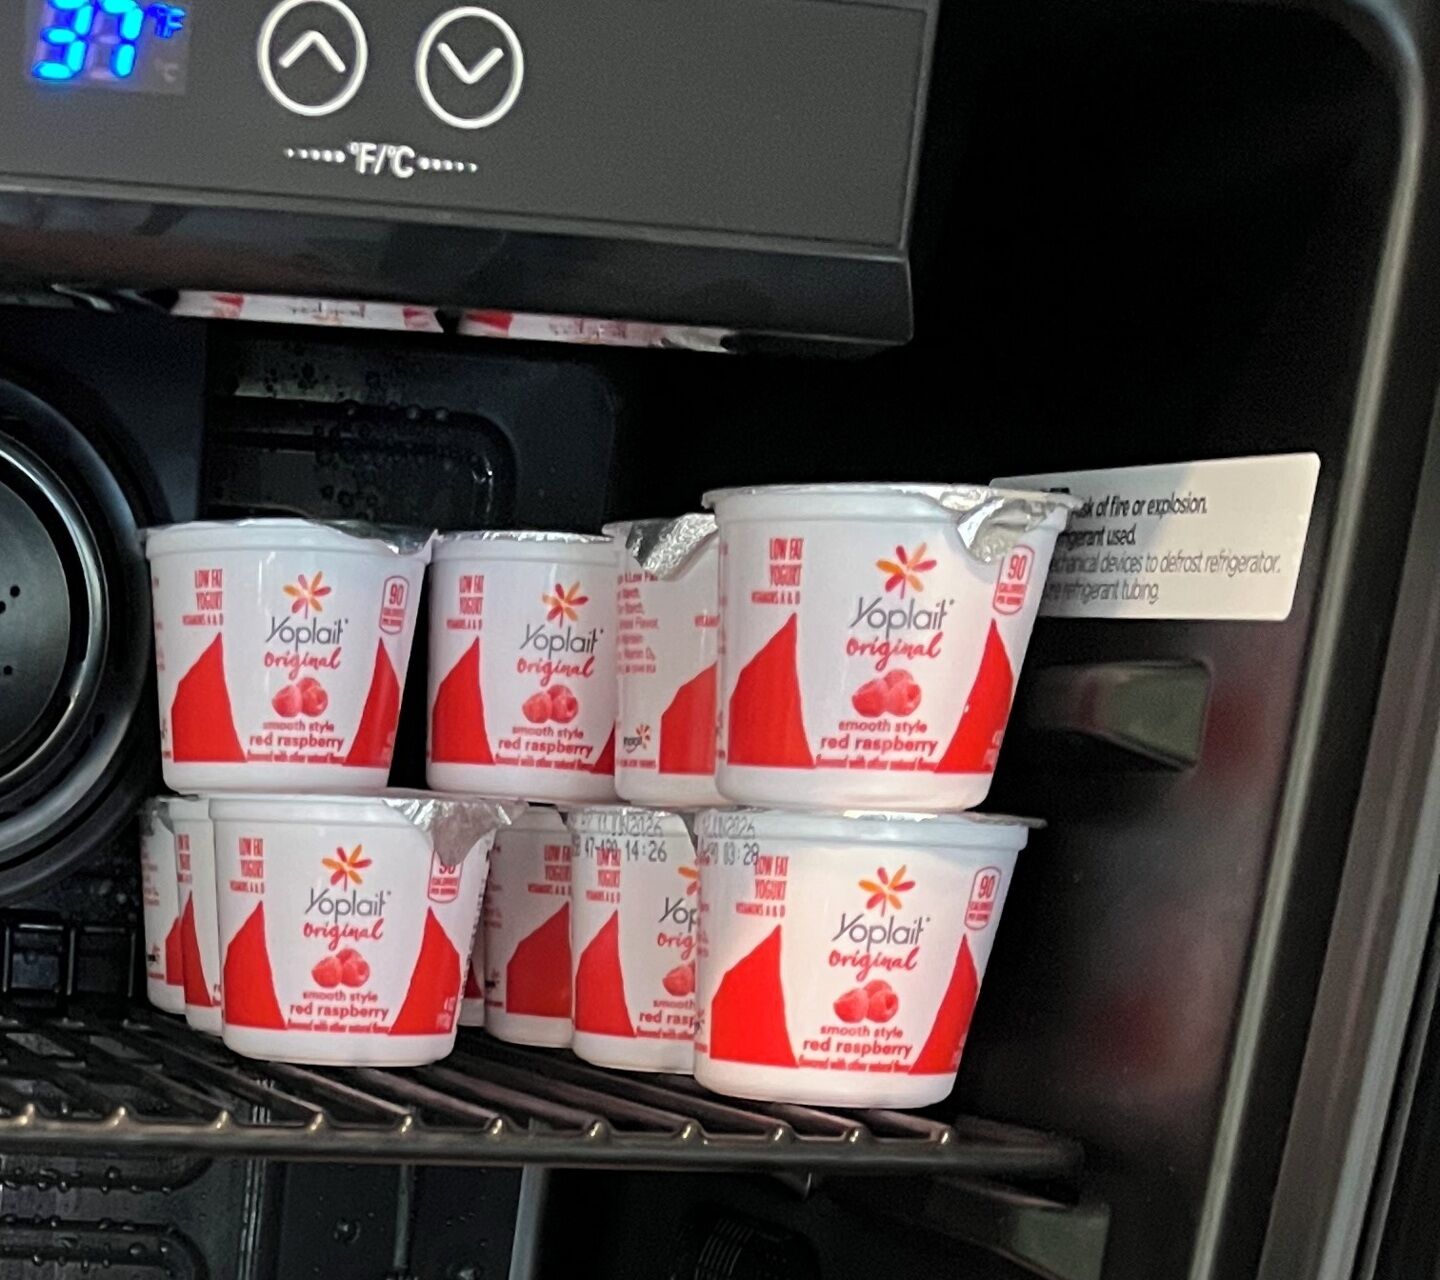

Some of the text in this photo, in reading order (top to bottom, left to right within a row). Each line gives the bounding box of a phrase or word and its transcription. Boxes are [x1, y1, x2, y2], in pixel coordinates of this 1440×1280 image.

[32, 0, 143, 79] 37
[1132, 498, 1146, 515] or
[769, 537, 804, 561] LOW FAT
[1007, 554, 1029, 581] 90
[1145, 553, 1158, 574] to
[1159, 549, 1204, 574] defrost
[1204, 549, 1281, 577] refrigerator.
[194, 568, 223, 589] LOW FAT
[769, 563, 802, 588] YOGURT
[389, 583, 404, 606] 90
[849, 596, 948, 641] Yoplait
[265, 616, 344, 651] Yoplait
[520, 623, 598, 659] Yoplait
[262, 721, 335, 734] smooth style
[512, 725, 584, 740] smooth style
[838, 719, 928, 736] smooth style
[249, 732, 345, 752] red raspberry
[498, 737, 594, 759] red raspberry
[820, 735, 939, 756] red raspberry
[625, 840, 668, 863] 14:26
[754, 855, 789, 877] LOW FAT
[754, 879, 787, 901] YOGURT
[978, 874, 994, 899] 90
[304, 887, 387, 922] Yoplait
[658, 897, 698, 927] Yop
[831, 912, 926, 952] Yoplait
[302, 990, 379, 1005] smooth style
[290, 1002, 390, 1021] red raspberry
[639, 1011, 662, 1025] red
[820, 1024, 904, 1040] smooth style
[803, 1037, 914, 1059] red raspberry
